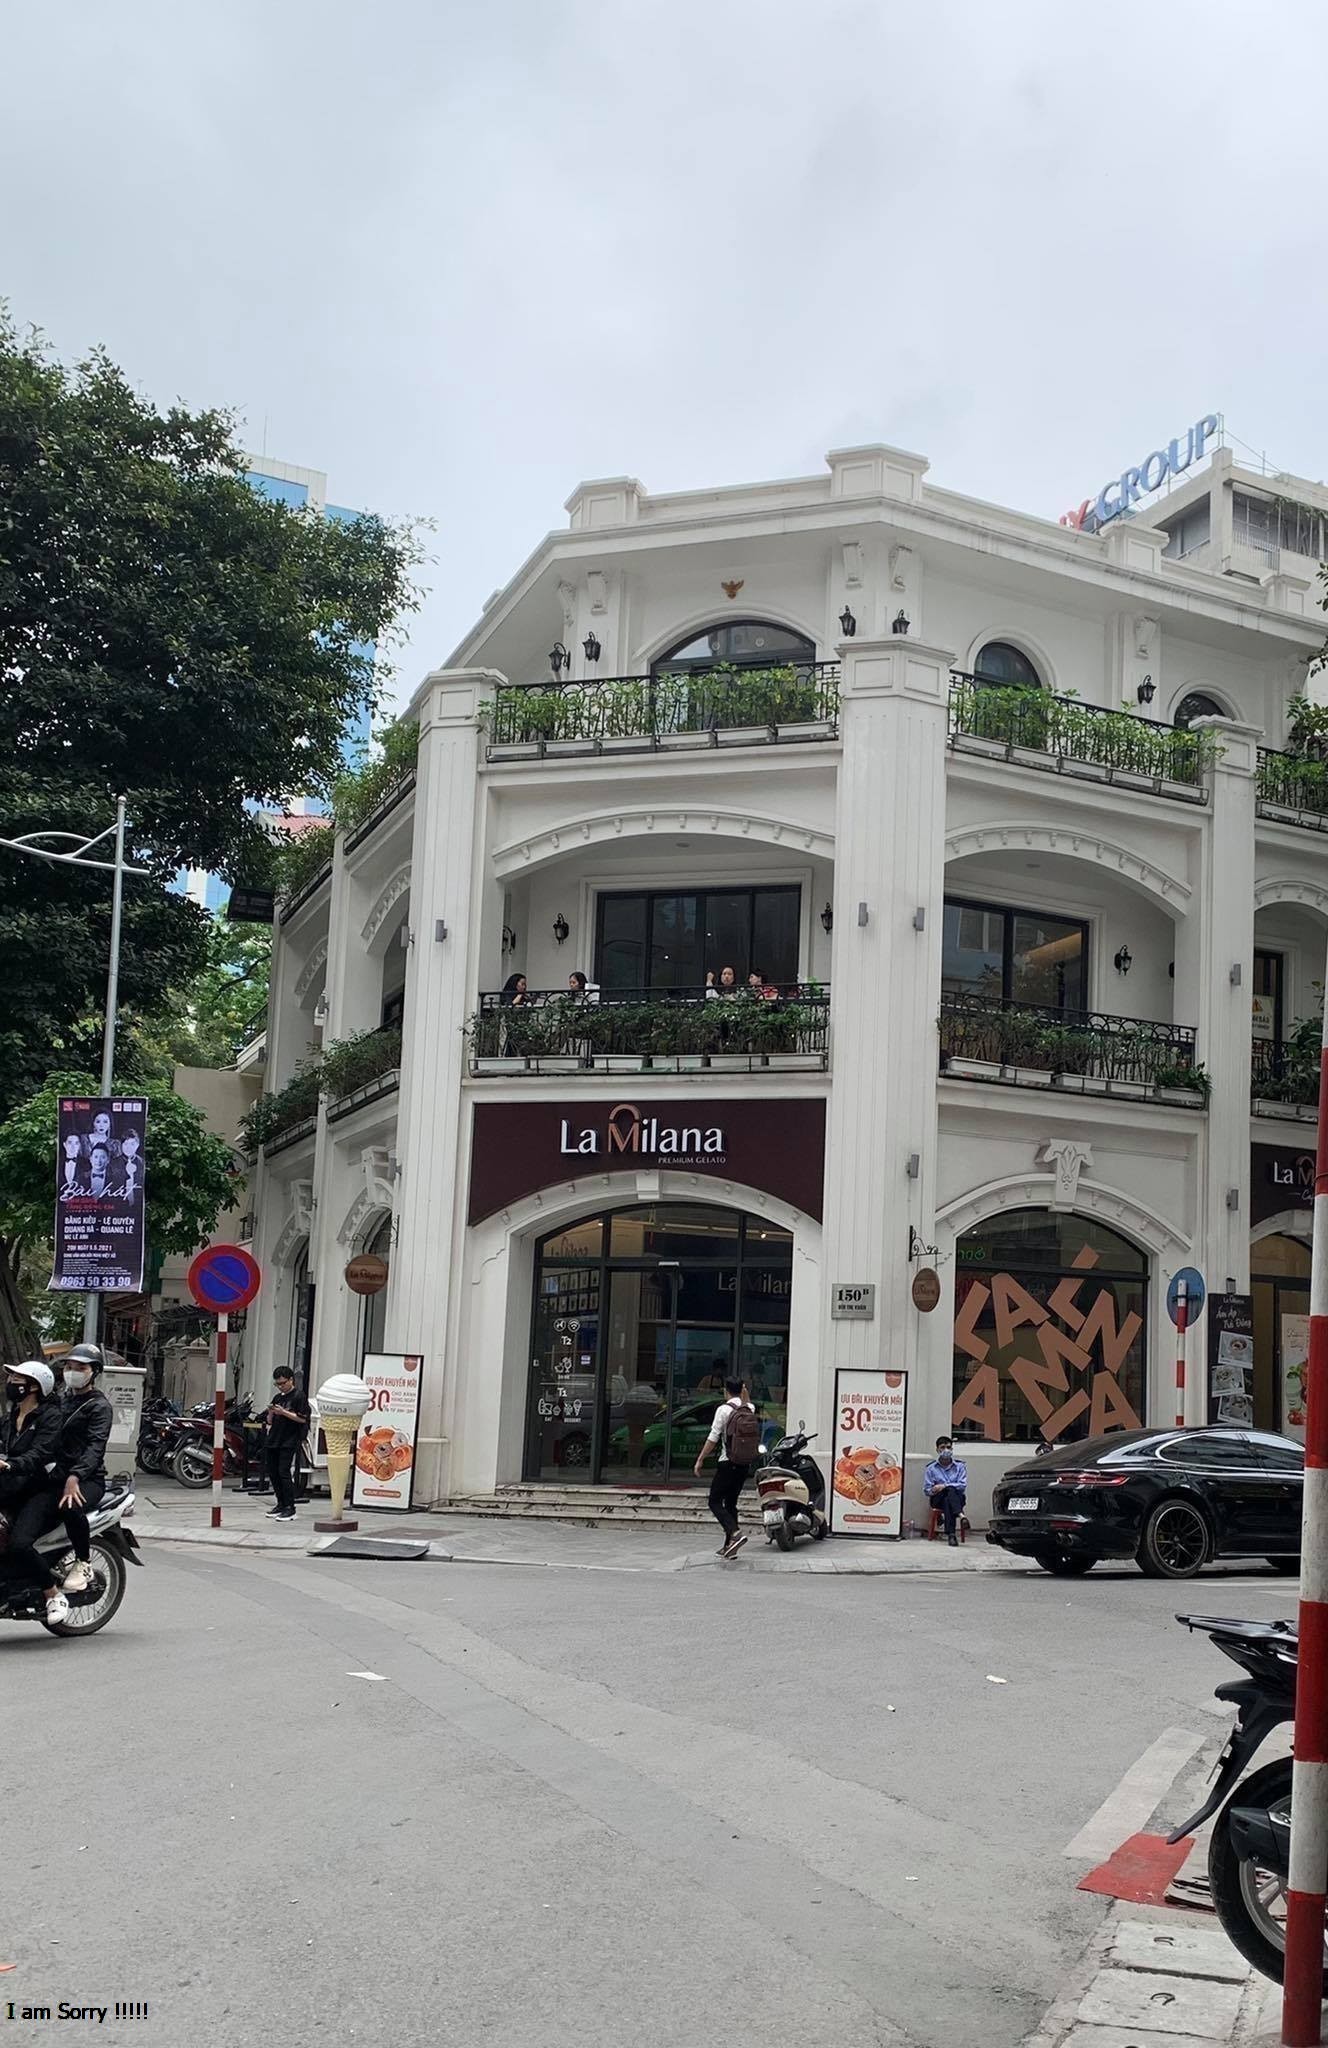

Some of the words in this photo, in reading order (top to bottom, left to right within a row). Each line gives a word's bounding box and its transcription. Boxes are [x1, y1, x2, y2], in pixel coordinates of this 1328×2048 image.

[1095, 414, 1218, 521] GROUP
[560, 1119, 598, 1153] La
[607, 1104, 724, 1153] Milana
[1274, 1161, 1293, 1184] La
[60, 1276, 85, 1287] 0963
[87, 1276, 99, 1287] 50
[102, 1276, 115, 1287] 33
[118, 1276, 131, 1287] 90
[561, 1336, 572, 1346] T2
[557, 1387, 568, 1397] T1
